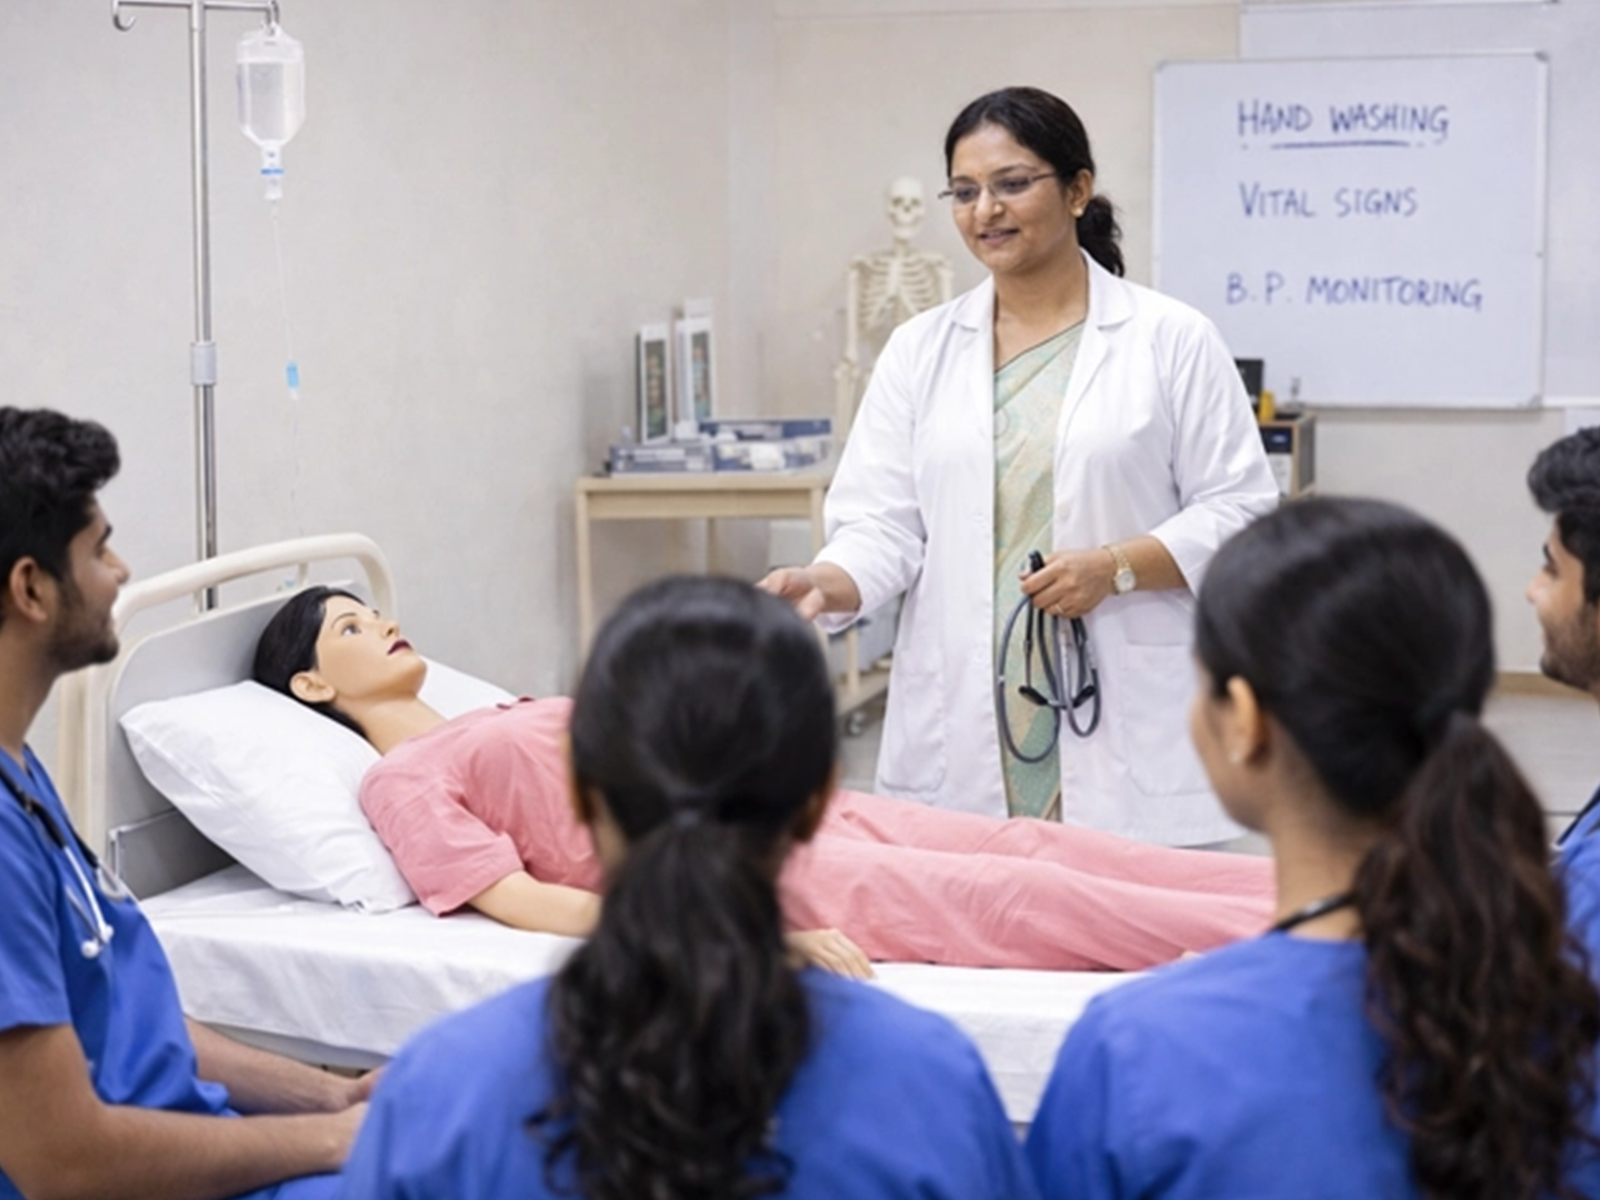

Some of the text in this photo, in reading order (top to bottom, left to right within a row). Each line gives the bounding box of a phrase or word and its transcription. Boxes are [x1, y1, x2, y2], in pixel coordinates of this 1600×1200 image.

[1238, 100, 1449, 142] HAND WASHING
[1239, 182, 1418, 218] VITAL SIGNS
[1305, 276, 1483, 311] MONITORING
